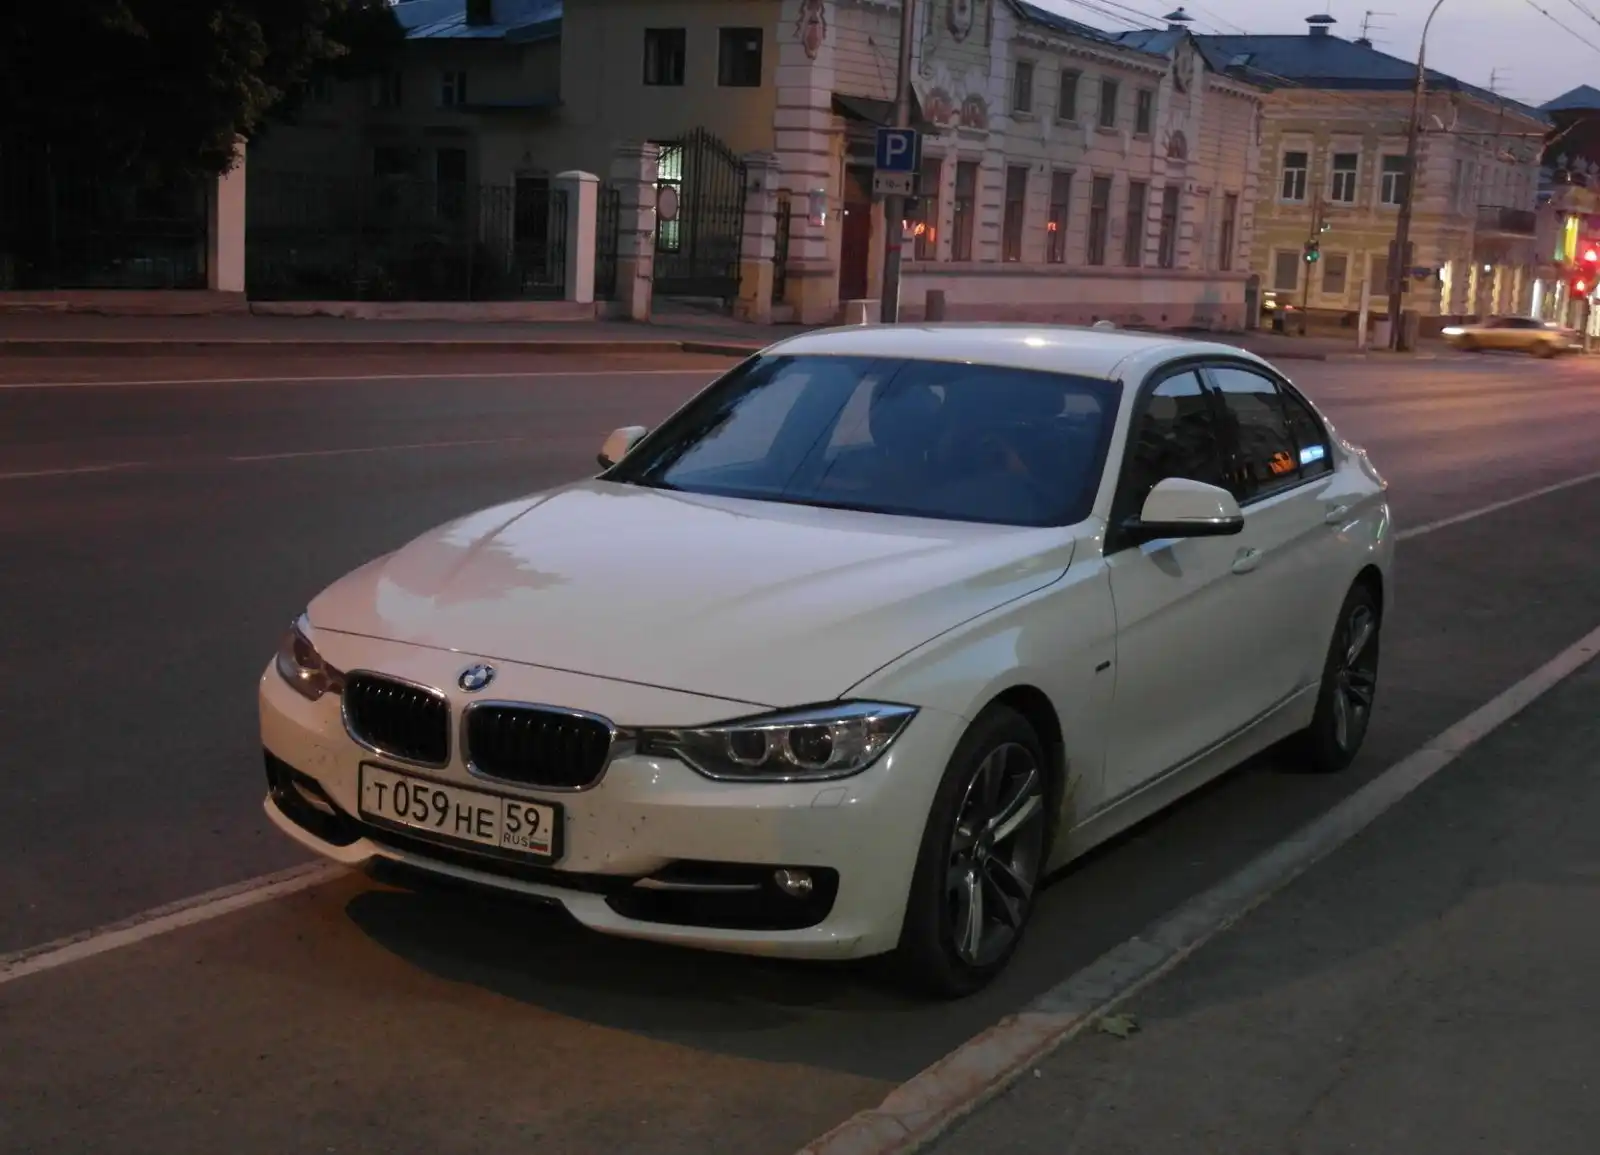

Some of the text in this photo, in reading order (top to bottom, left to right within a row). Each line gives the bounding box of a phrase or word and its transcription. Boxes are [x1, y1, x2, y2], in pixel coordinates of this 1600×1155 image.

[885, 133, 908, 167] P
[505, 803, 540, 837] 59
[503, 833, 529, 847] RUS
